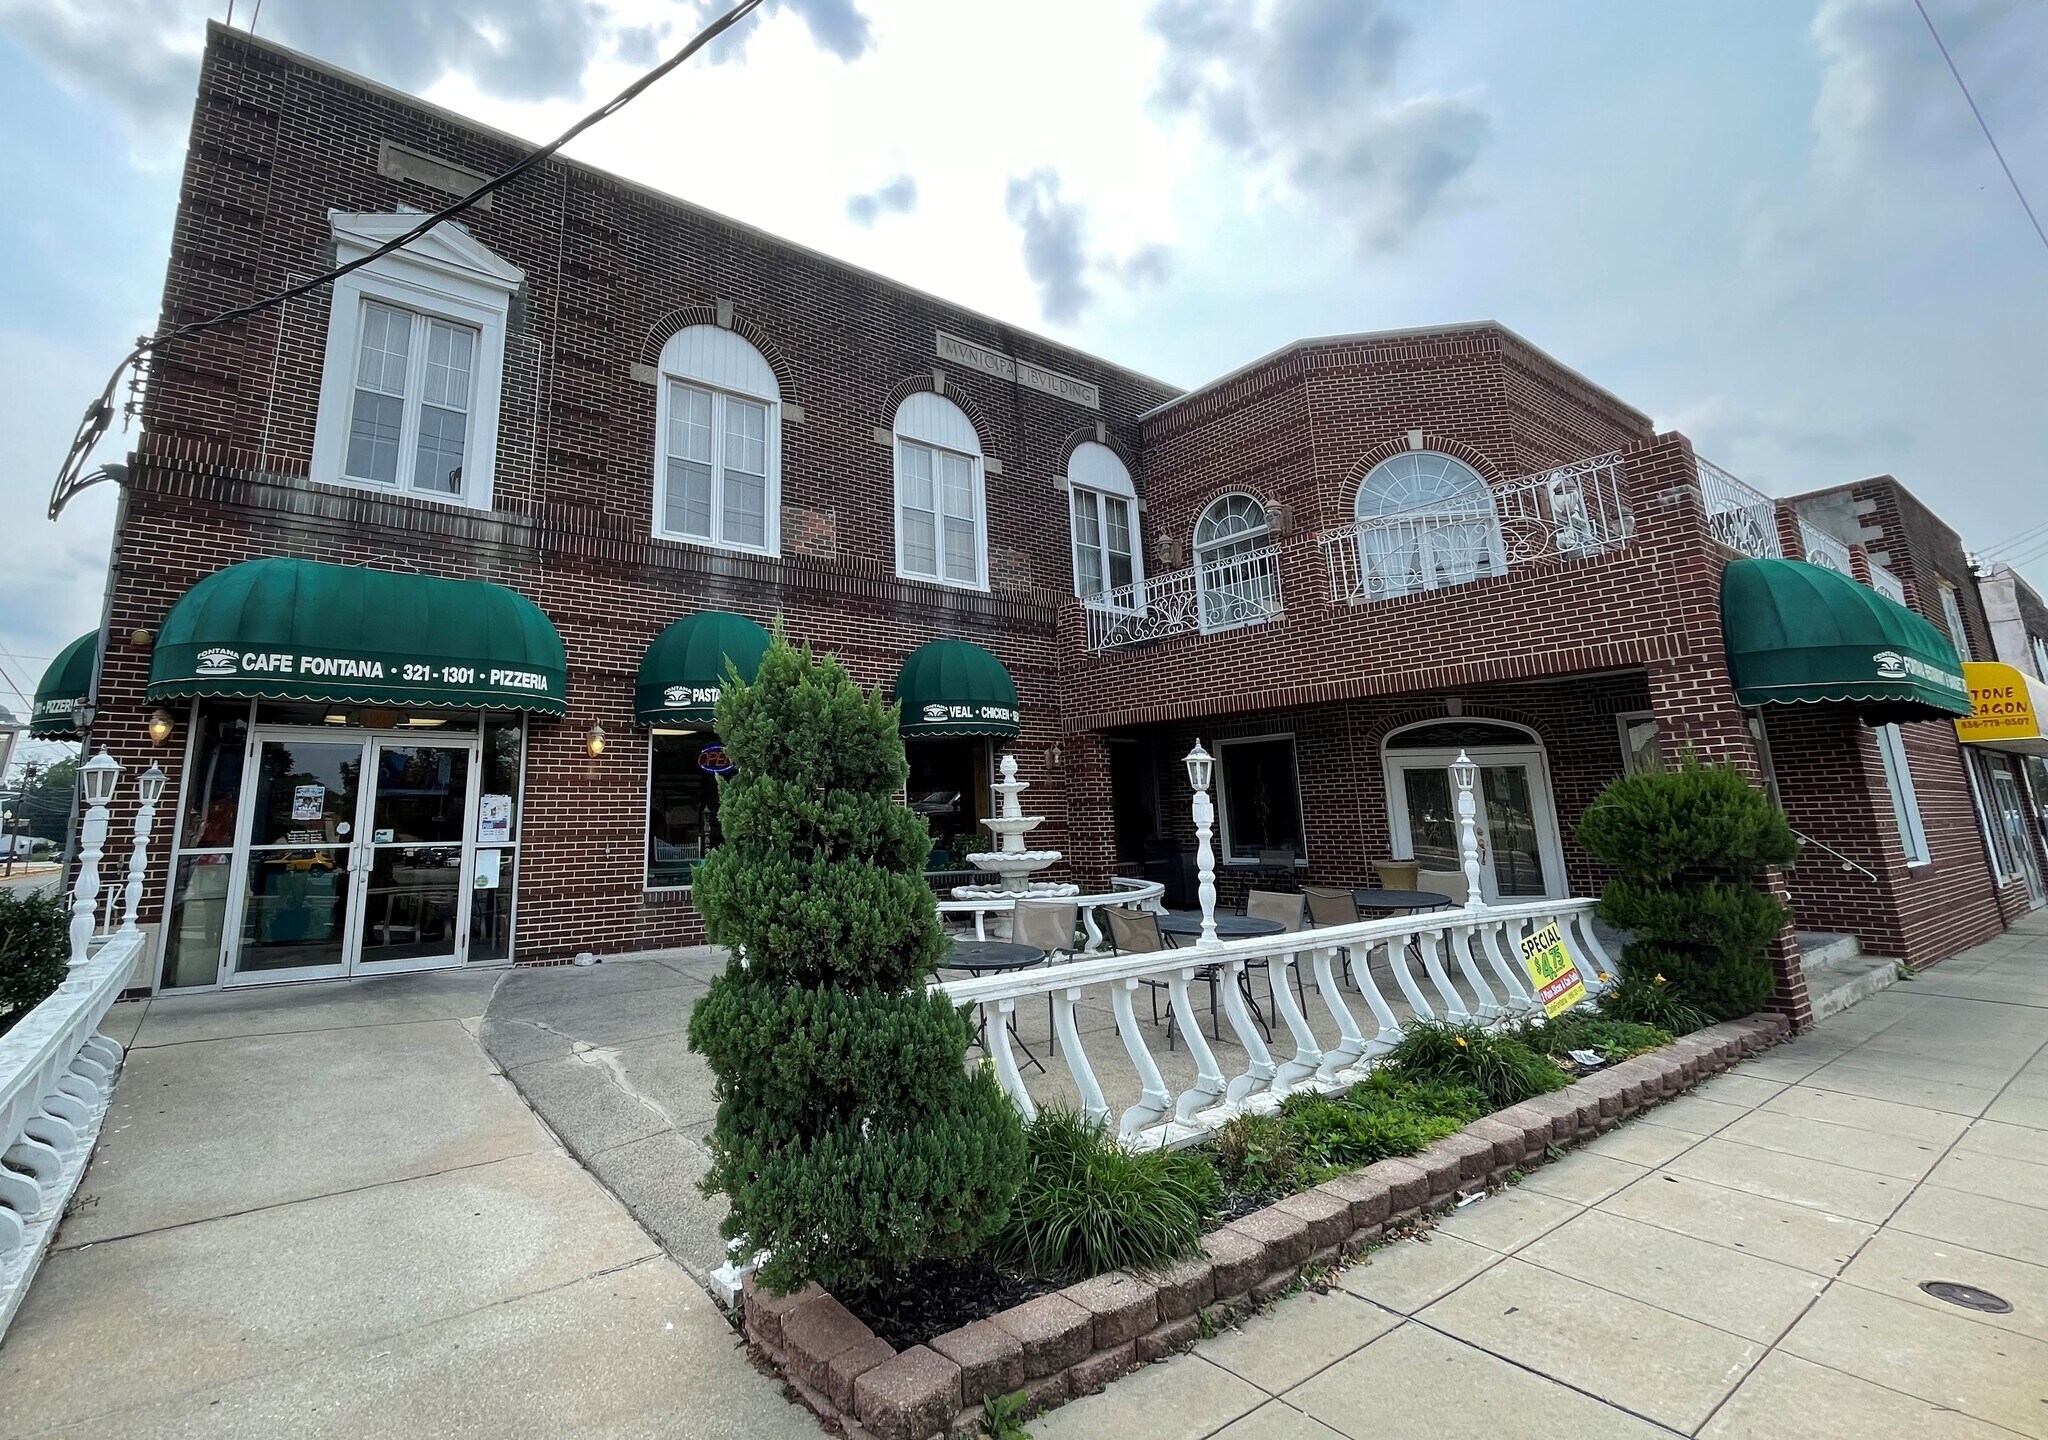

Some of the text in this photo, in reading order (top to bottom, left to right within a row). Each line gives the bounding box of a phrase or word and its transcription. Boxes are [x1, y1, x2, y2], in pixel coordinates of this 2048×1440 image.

[197, 647, 239, 659] FONTANA
[242, 653, 548, 691] CAFE FONTANA 321-1301 PIZZERIA
[1970, 687, 2013, 700] TONE
[45, 699, 78, 714] PIZZERI
[949, 706, 973, 718] VEAL
[981, 706, 1010, 720] CHICKEN
[1971, 702, 2027, 716] RAGON
[1521, 926, 1561, 960] SPECIAL
